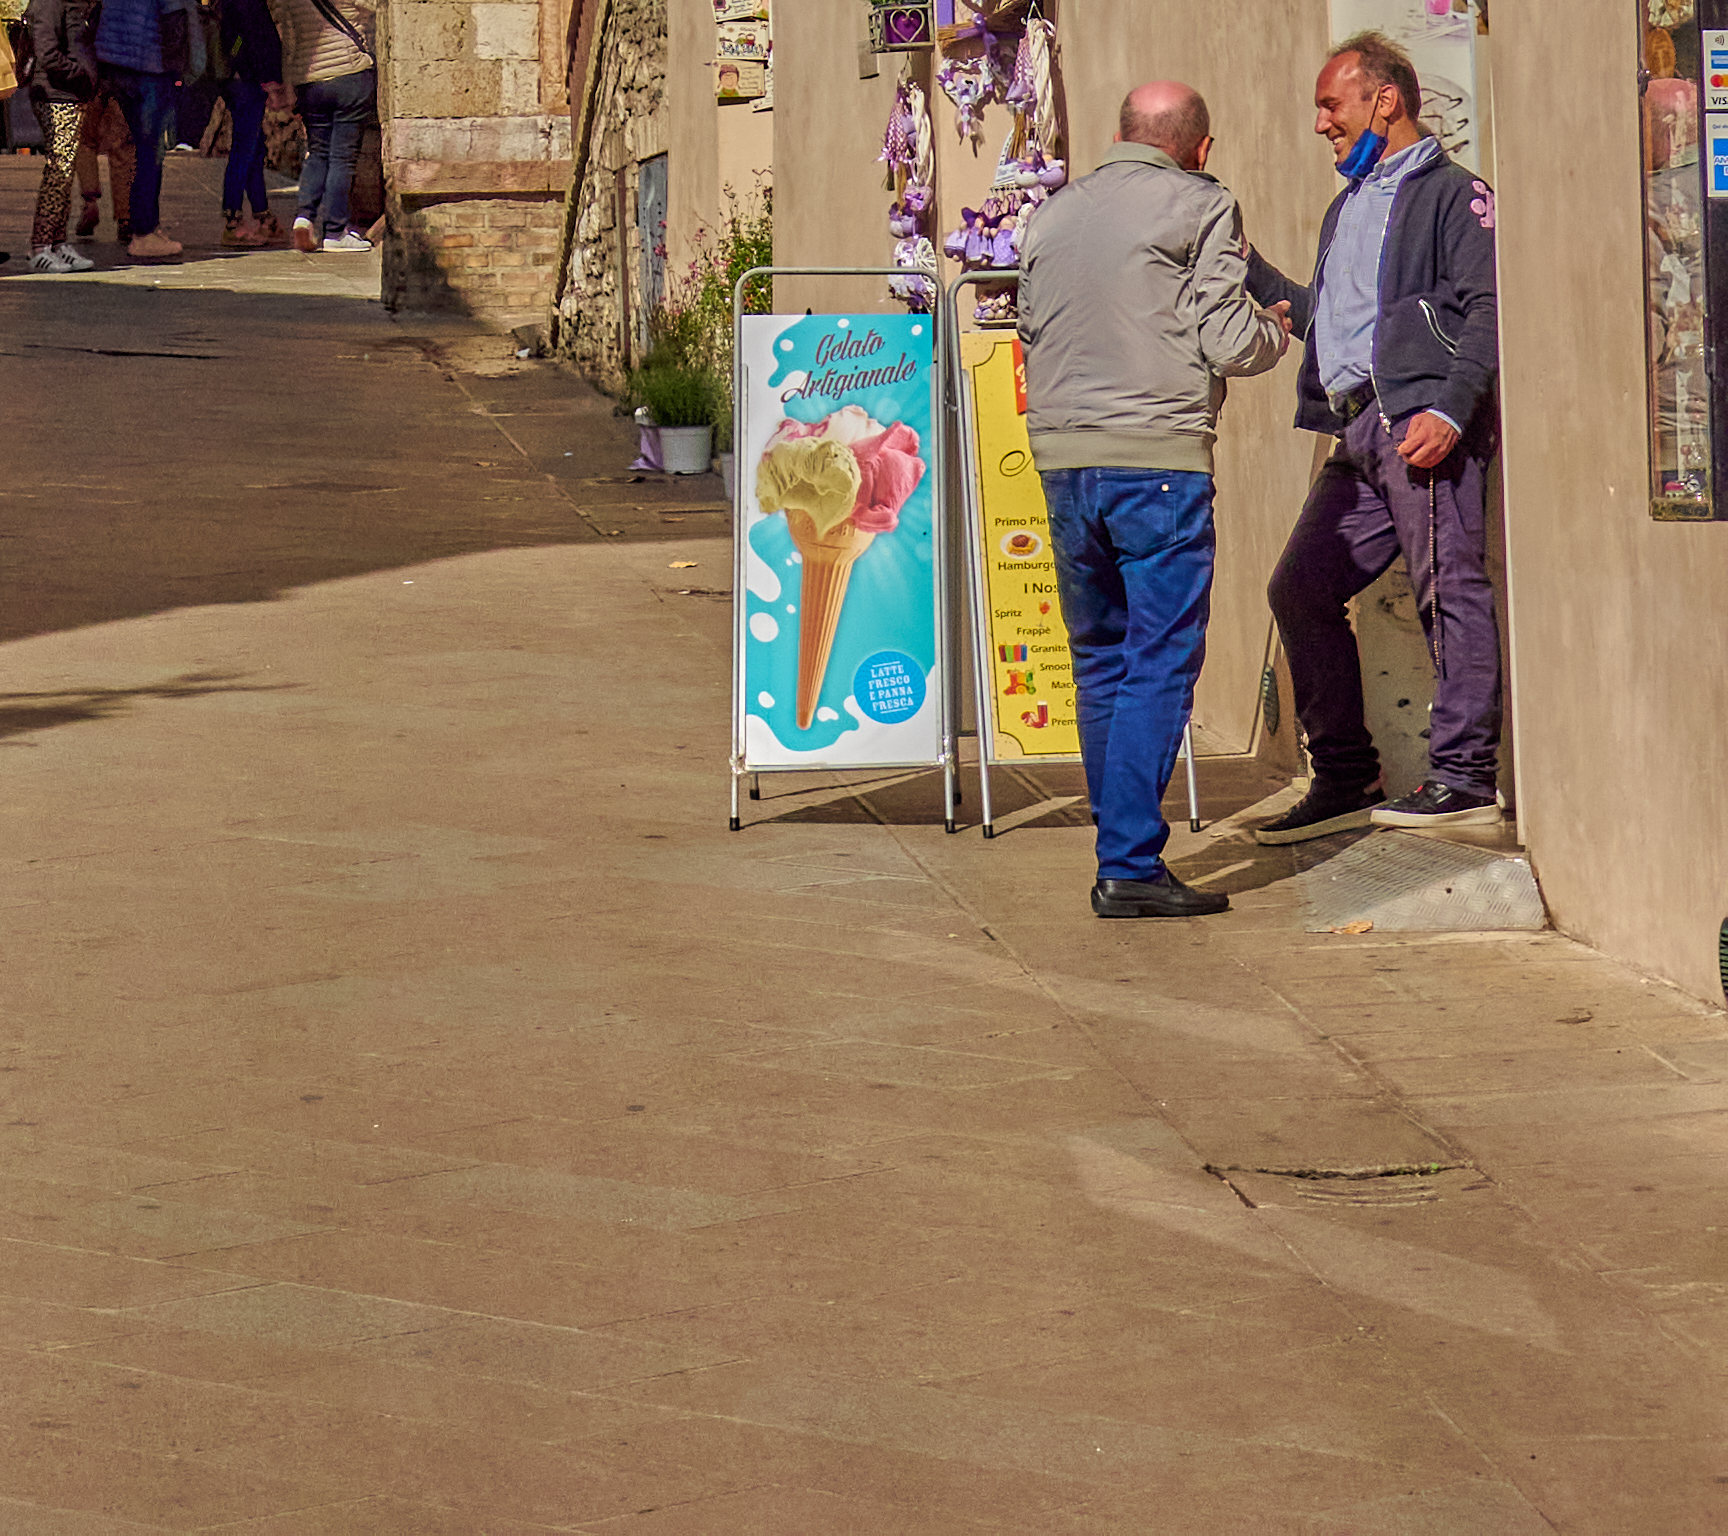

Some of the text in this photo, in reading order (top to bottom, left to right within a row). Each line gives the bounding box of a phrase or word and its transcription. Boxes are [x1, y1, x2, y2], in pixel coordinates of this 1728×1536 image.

[1711, 96, 1728, 106] VIS
[815, 328, 886, 368] Gelato
[780, 351, 917, 403] Artigianale
[995, 516, 1046, 526] Primo Pia
[1032, 582, 1059, 594] Nos
[995, 609, 1022, 619] Spritz
[870, 664, 904, 678] LATTE
[1040, 663, 1069, 671] Smoot
[868, 675, 910, 690] FRESCO
[869, 685, 913, 701] E PANNA
[872, 696, 914, 712] FRESCA
[1052, 718, 1076, 726] Prem
